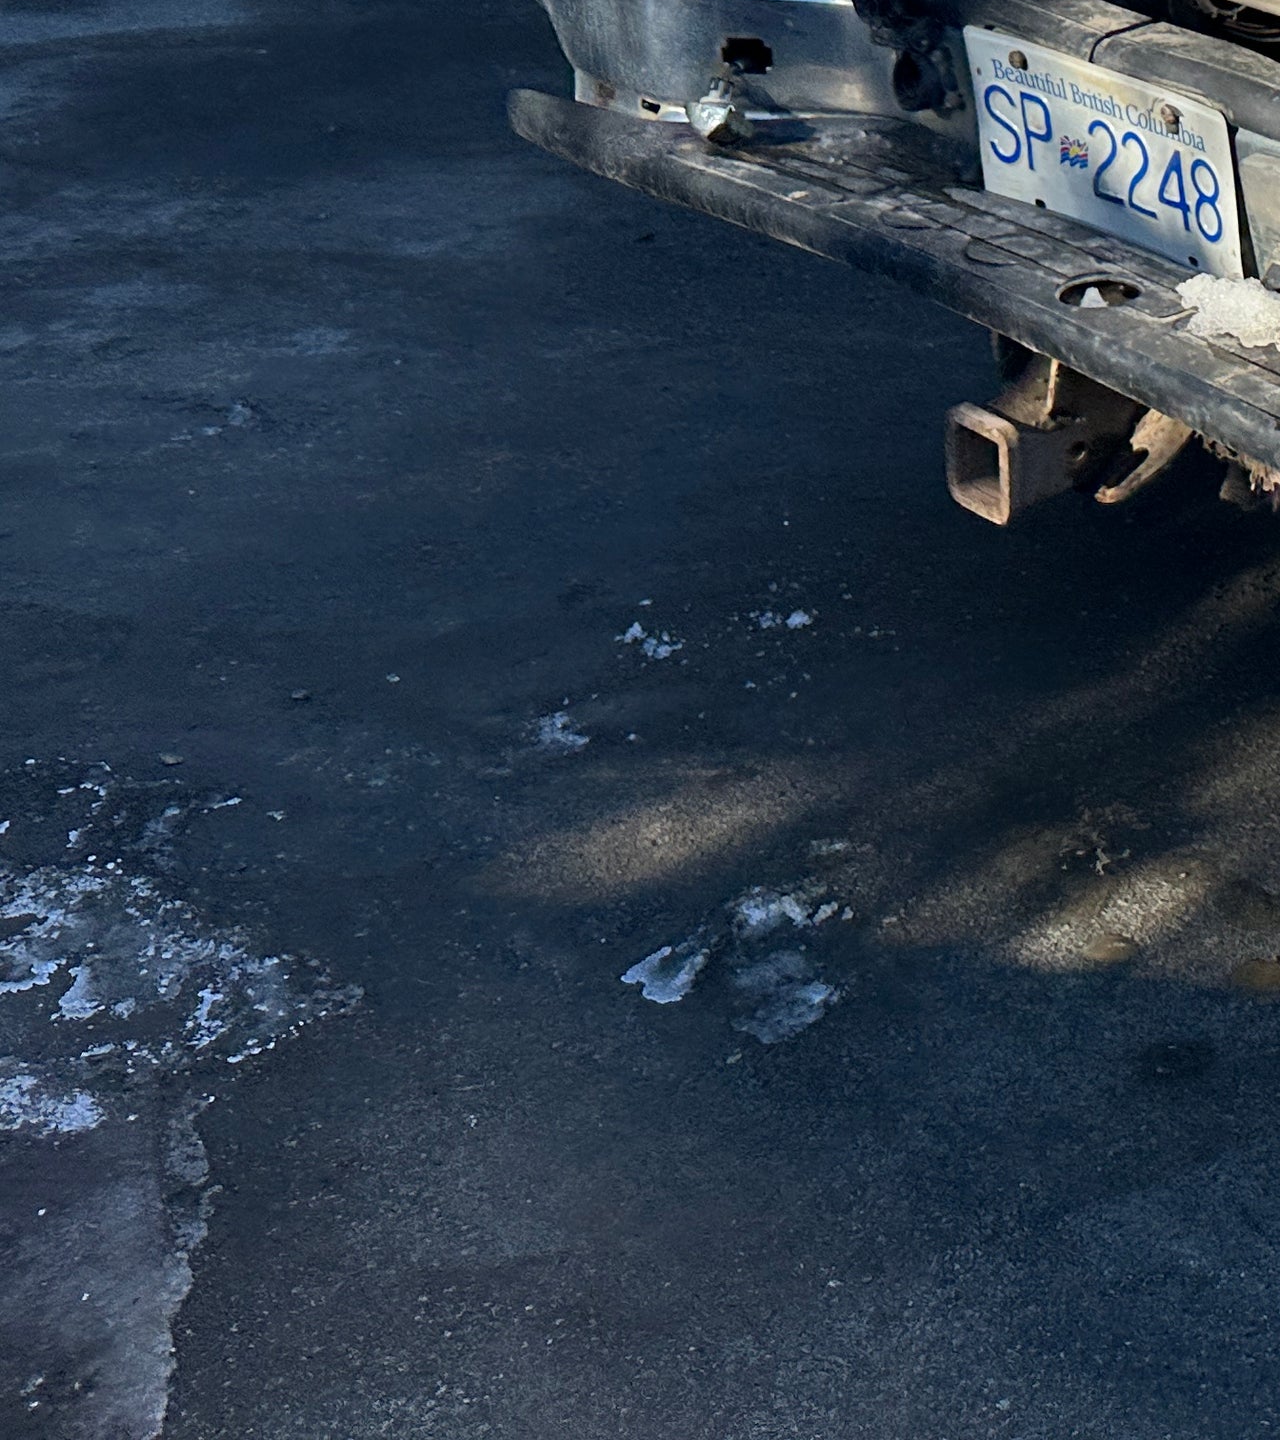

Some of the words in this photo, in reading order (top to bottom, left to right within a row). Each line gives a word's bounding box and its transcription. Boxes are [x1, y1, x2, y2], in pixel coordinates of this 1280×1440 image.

[991, 58, 1068, 100] Beautiful
[1071, 83, 1124, 121] British
[983, 83, 1054, 172] SP
[1087, 118, 1223, 244] 2248
